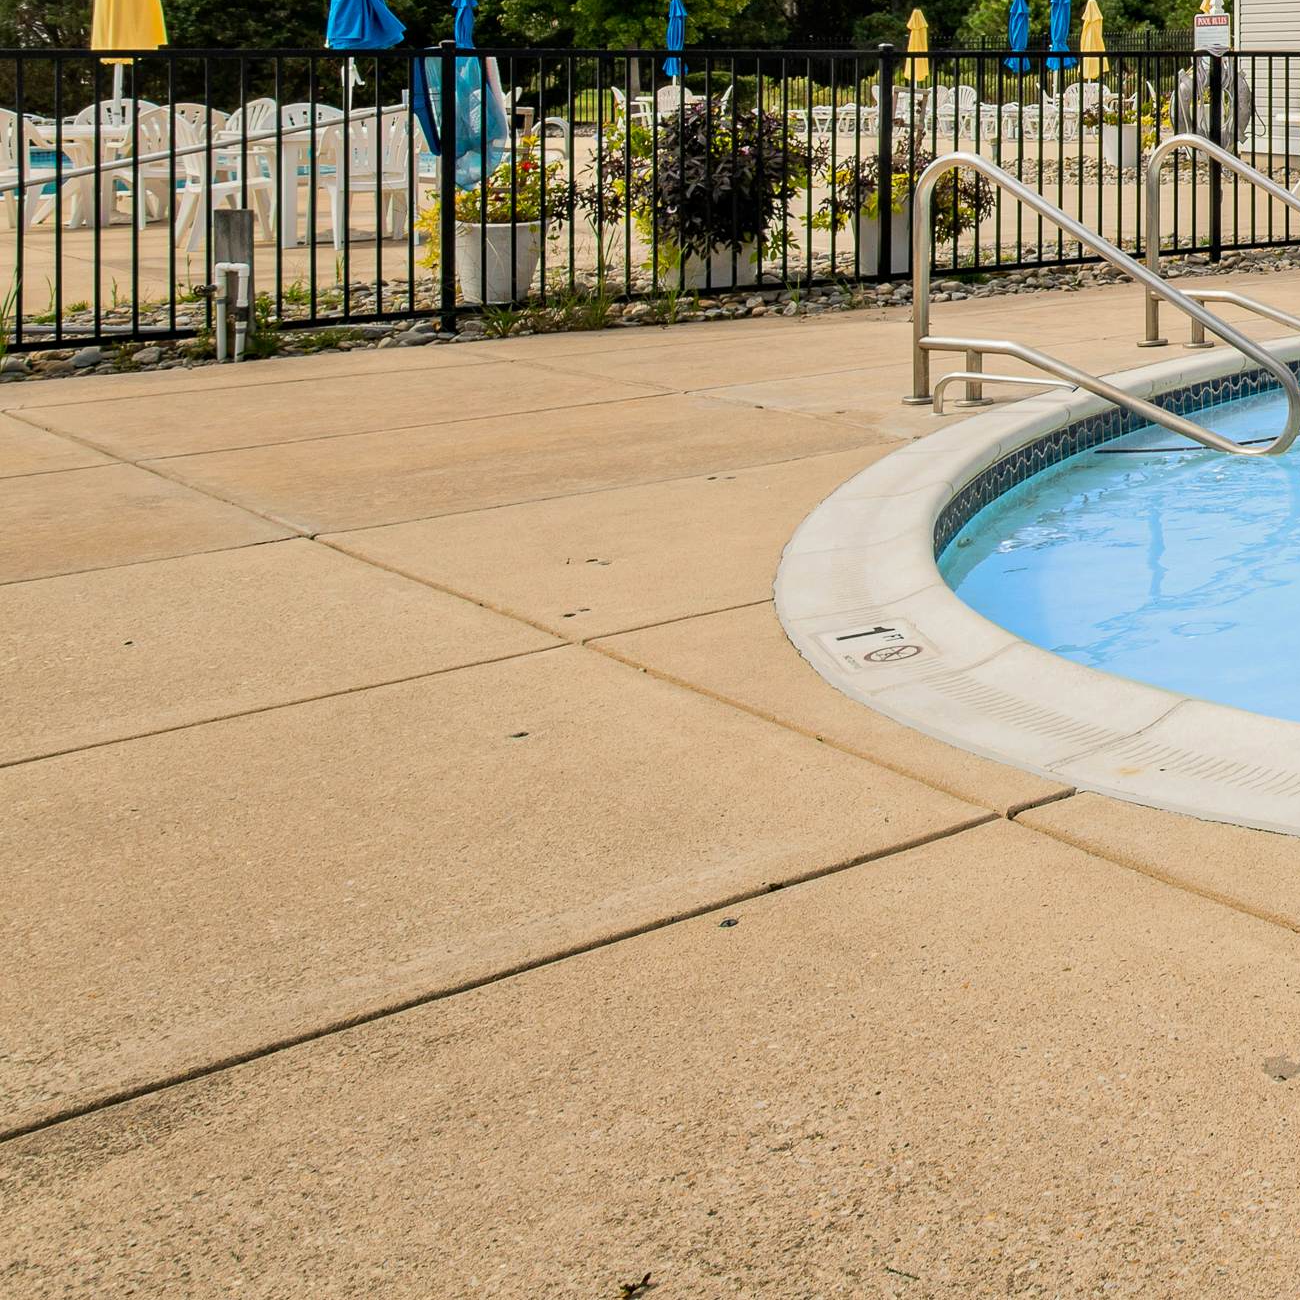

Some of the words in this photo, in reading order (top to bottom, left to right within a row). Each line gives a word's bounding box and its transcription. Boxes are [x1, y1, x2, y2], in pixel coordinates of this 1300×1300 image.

[1197, 16, 1211, 26] POOL
[1212, 15, 1227, 25] RULES
[836, 626, 896, 641] 1
